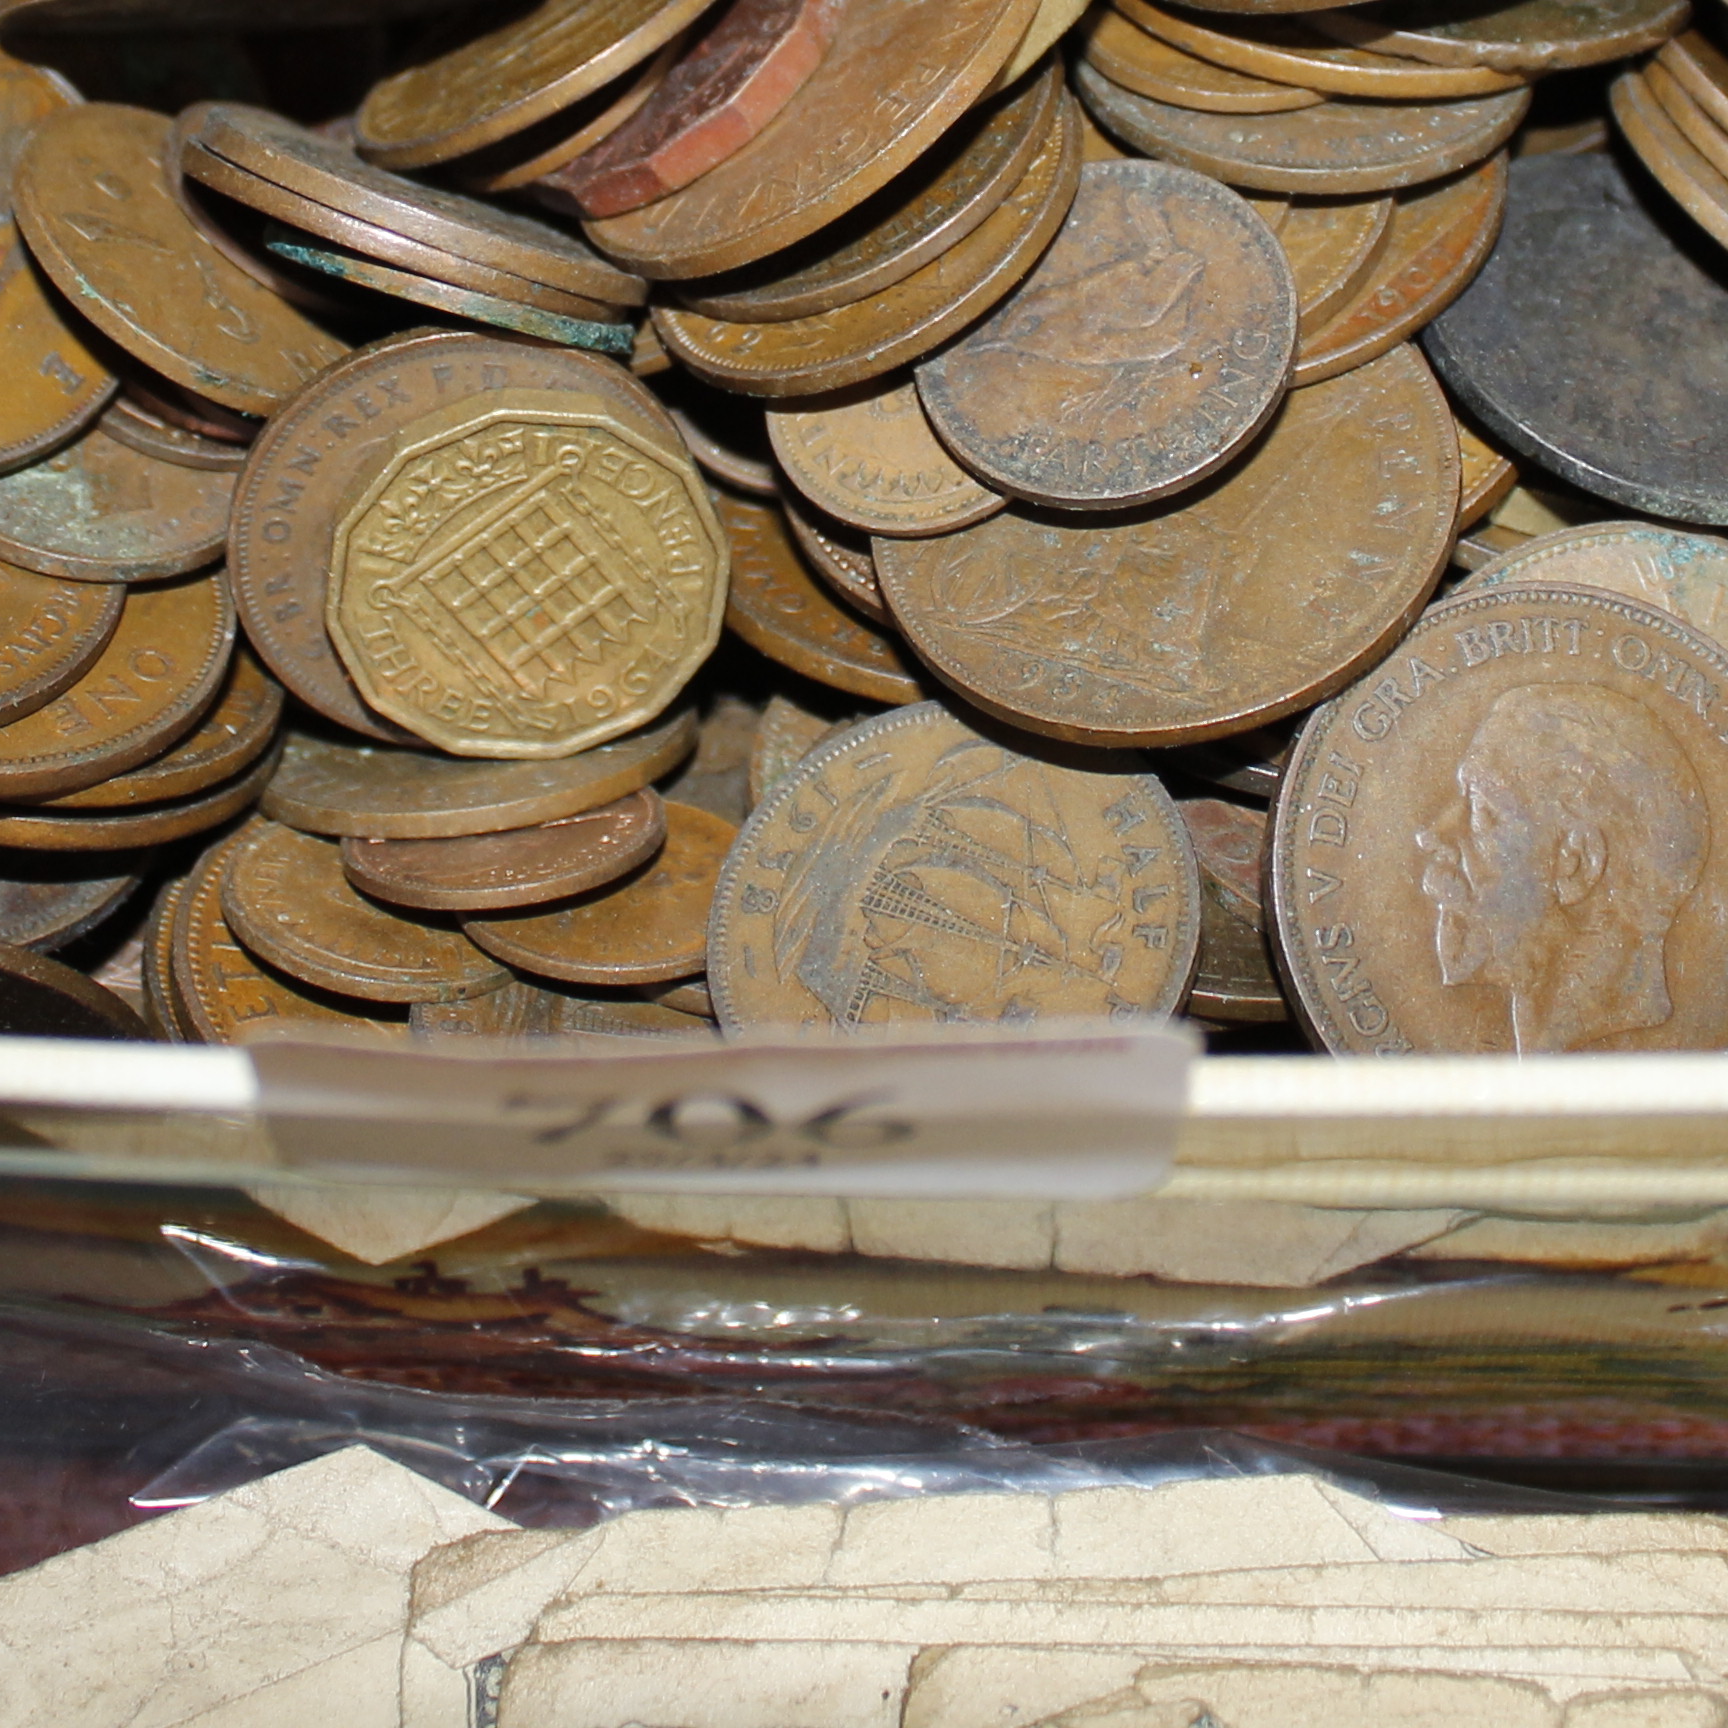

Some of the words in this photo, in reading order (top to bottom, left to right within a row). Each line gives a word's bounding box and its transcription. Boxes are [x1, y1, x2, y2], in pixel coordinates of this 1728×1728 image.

[322, 375, 414, 440] REX
[600, 444, 704, 594] PENCE
[54, 646, 174, 738] ONE
[361, 616, 494, 734] THREE
[562, 639, 683, 725] 1964
[739, 782, 841, 915] 1938
[1307, 754, 1368, 849] DEI
[1102, 791, 1173, 951] HALF
[1307, 869, 1345, 906] V
[501, 1082, 916, 1148] 706
